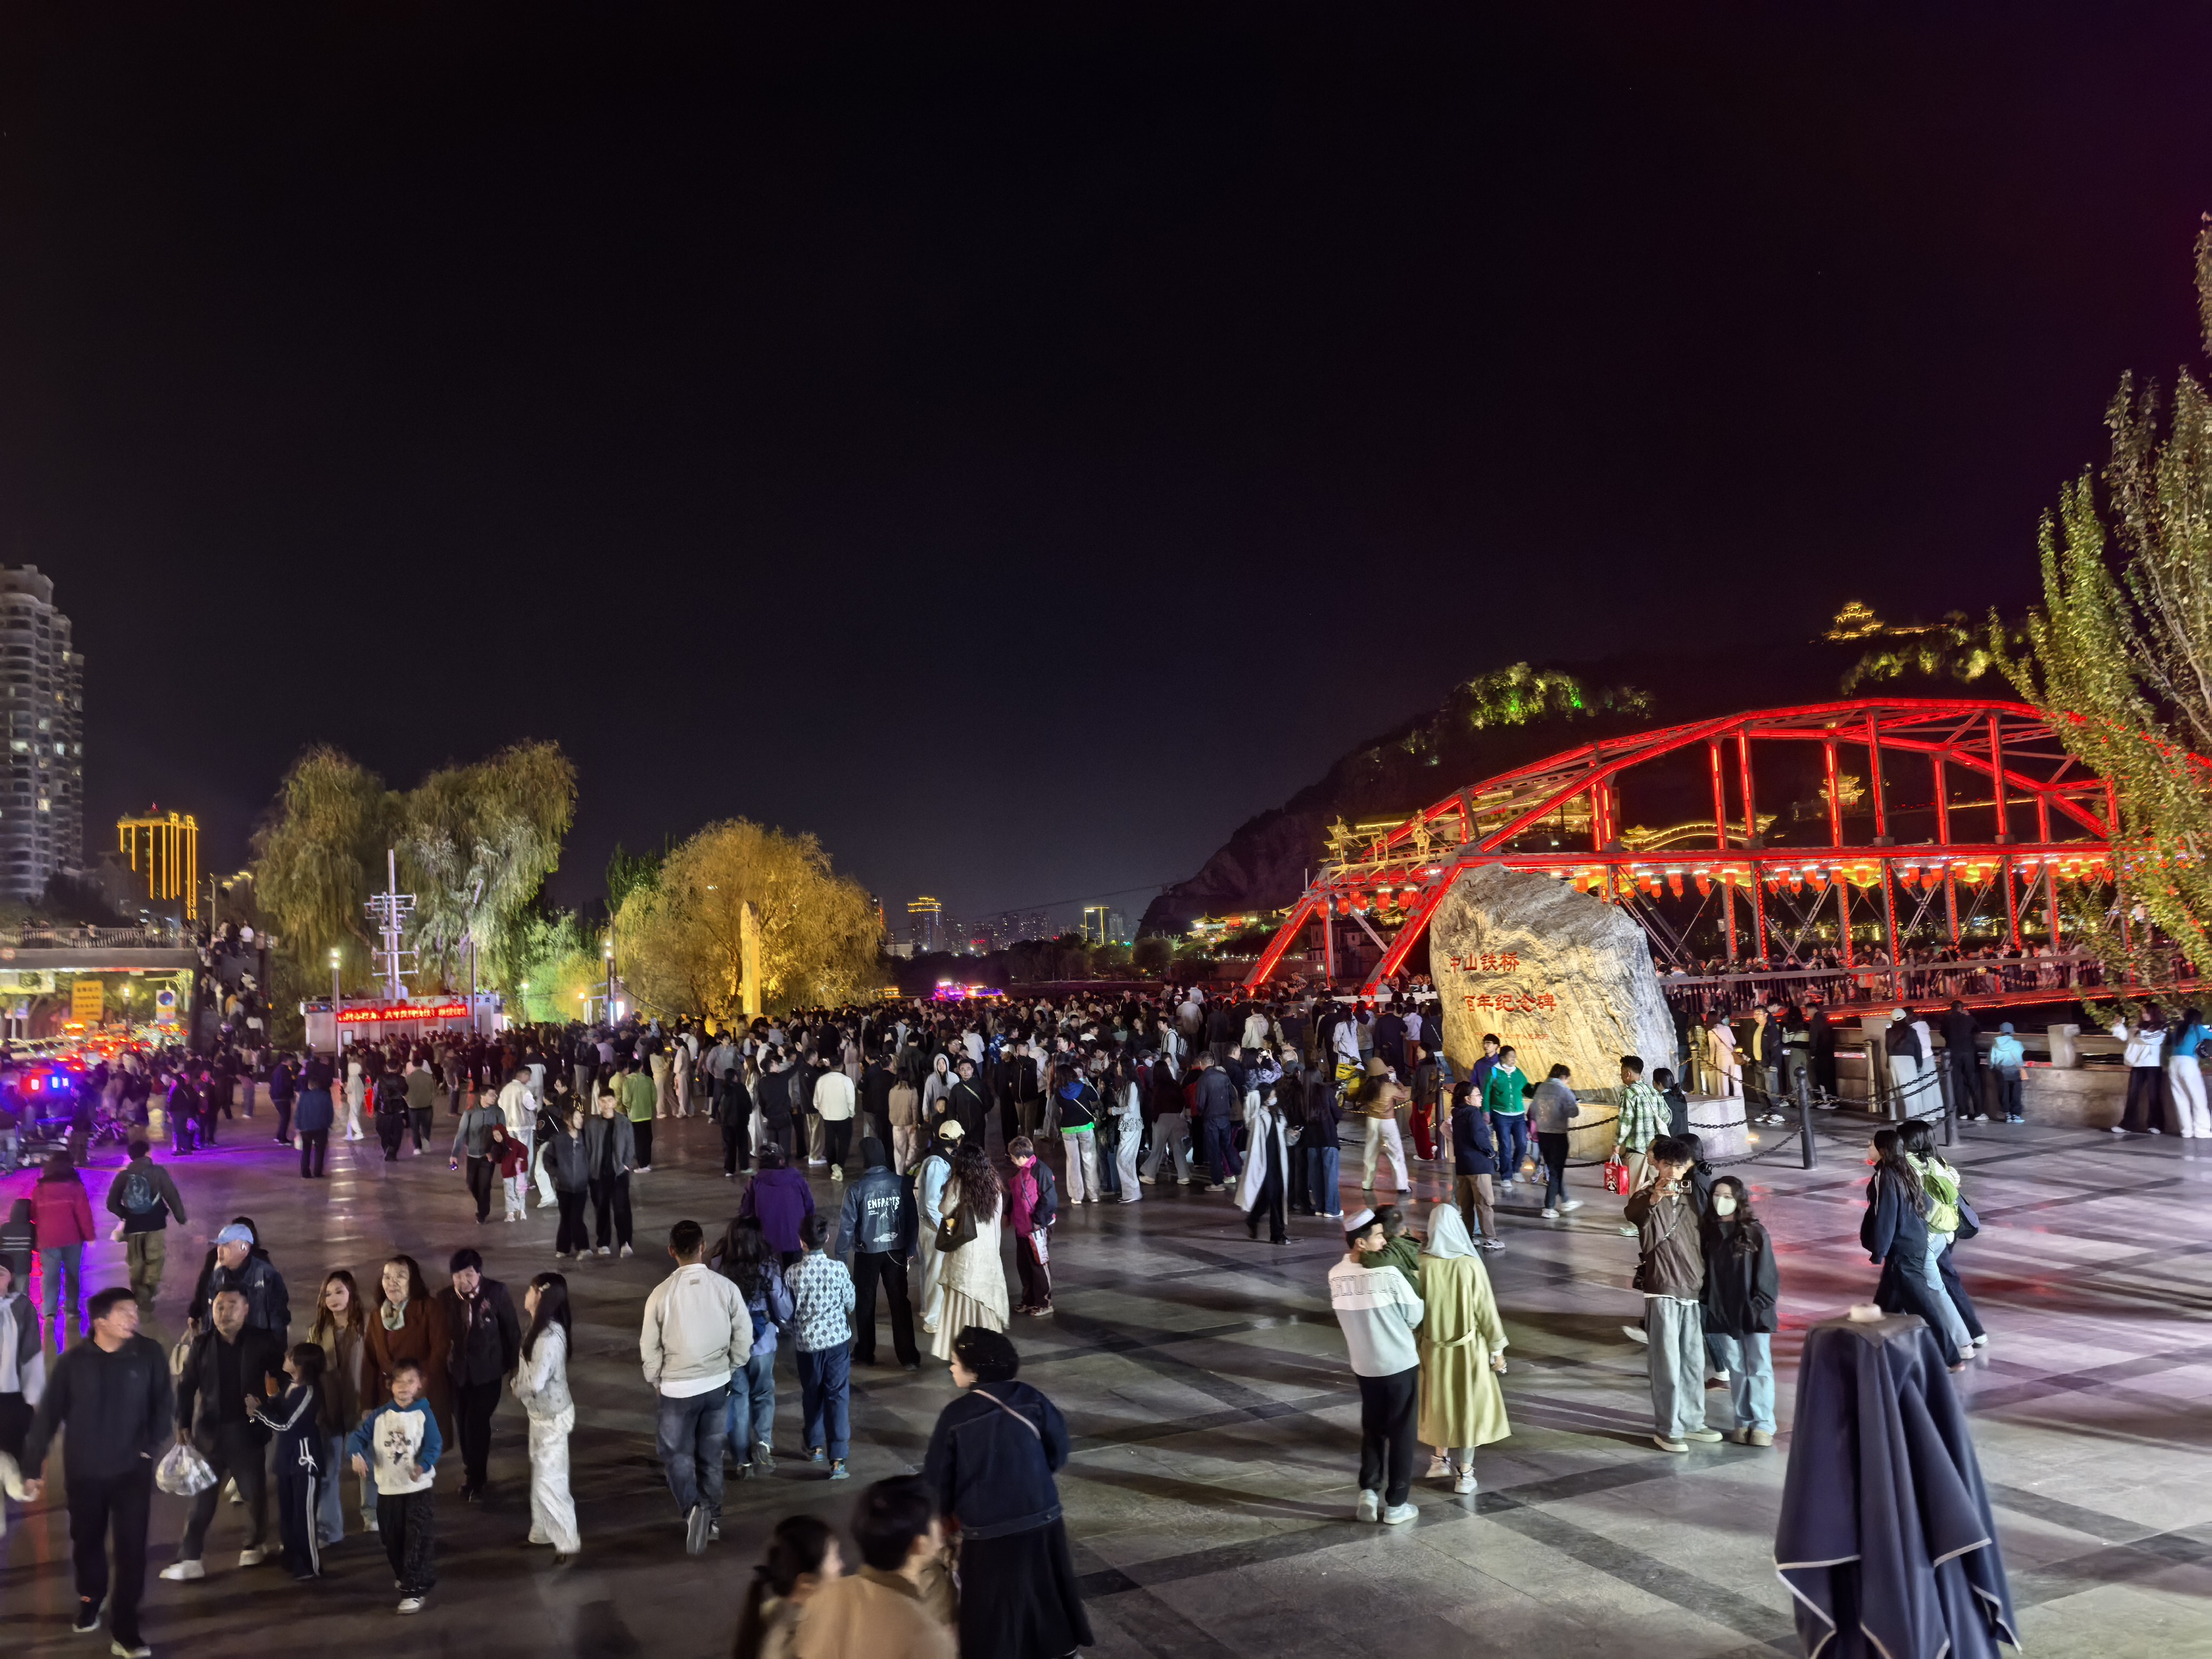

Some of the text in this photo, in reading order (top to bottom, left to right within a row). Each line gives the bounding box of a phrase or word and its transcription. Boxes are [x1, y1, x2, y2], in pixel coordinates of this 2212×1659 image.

[1450, 950, 1520, 974] 中山铁桥
[1464, 992, 1557, 1012] 百年纪念碑
